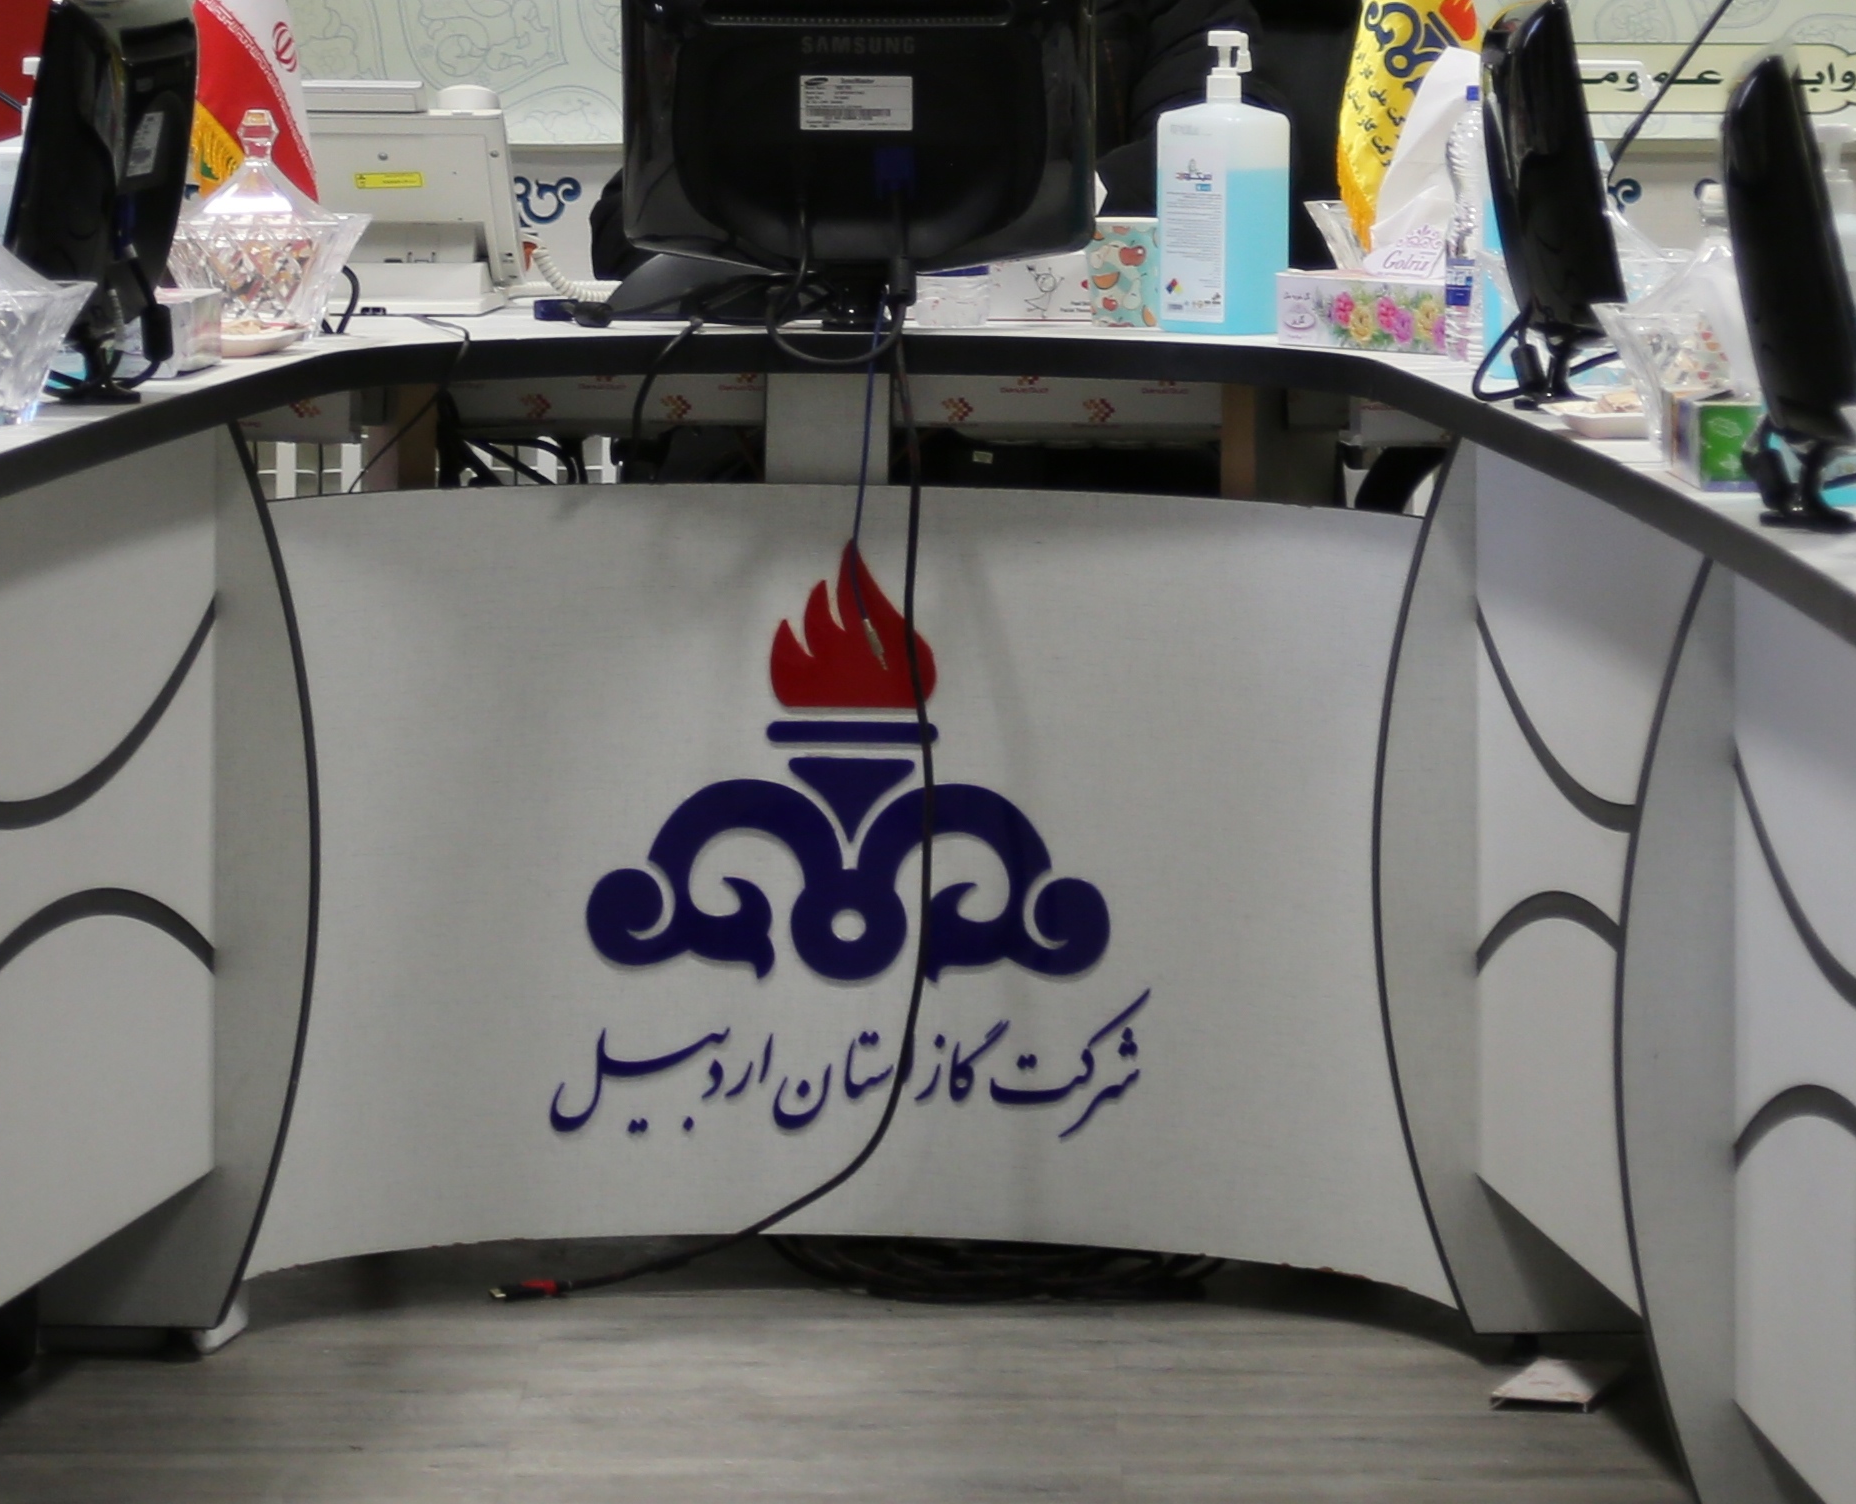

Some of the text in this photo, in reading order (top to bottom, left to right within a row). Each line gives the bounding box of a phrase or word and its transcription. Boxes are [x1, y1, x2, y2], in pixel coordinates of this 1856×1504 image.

[801, 35, 916, 55] SAMSUNG
[1383, 249, 1431, 272] Golriz
[549, 1026, 775, 1135] اردبیل
[914, 1019, 1011, 1104] گاز
[989, 988, 1151, 1140] شرکت
